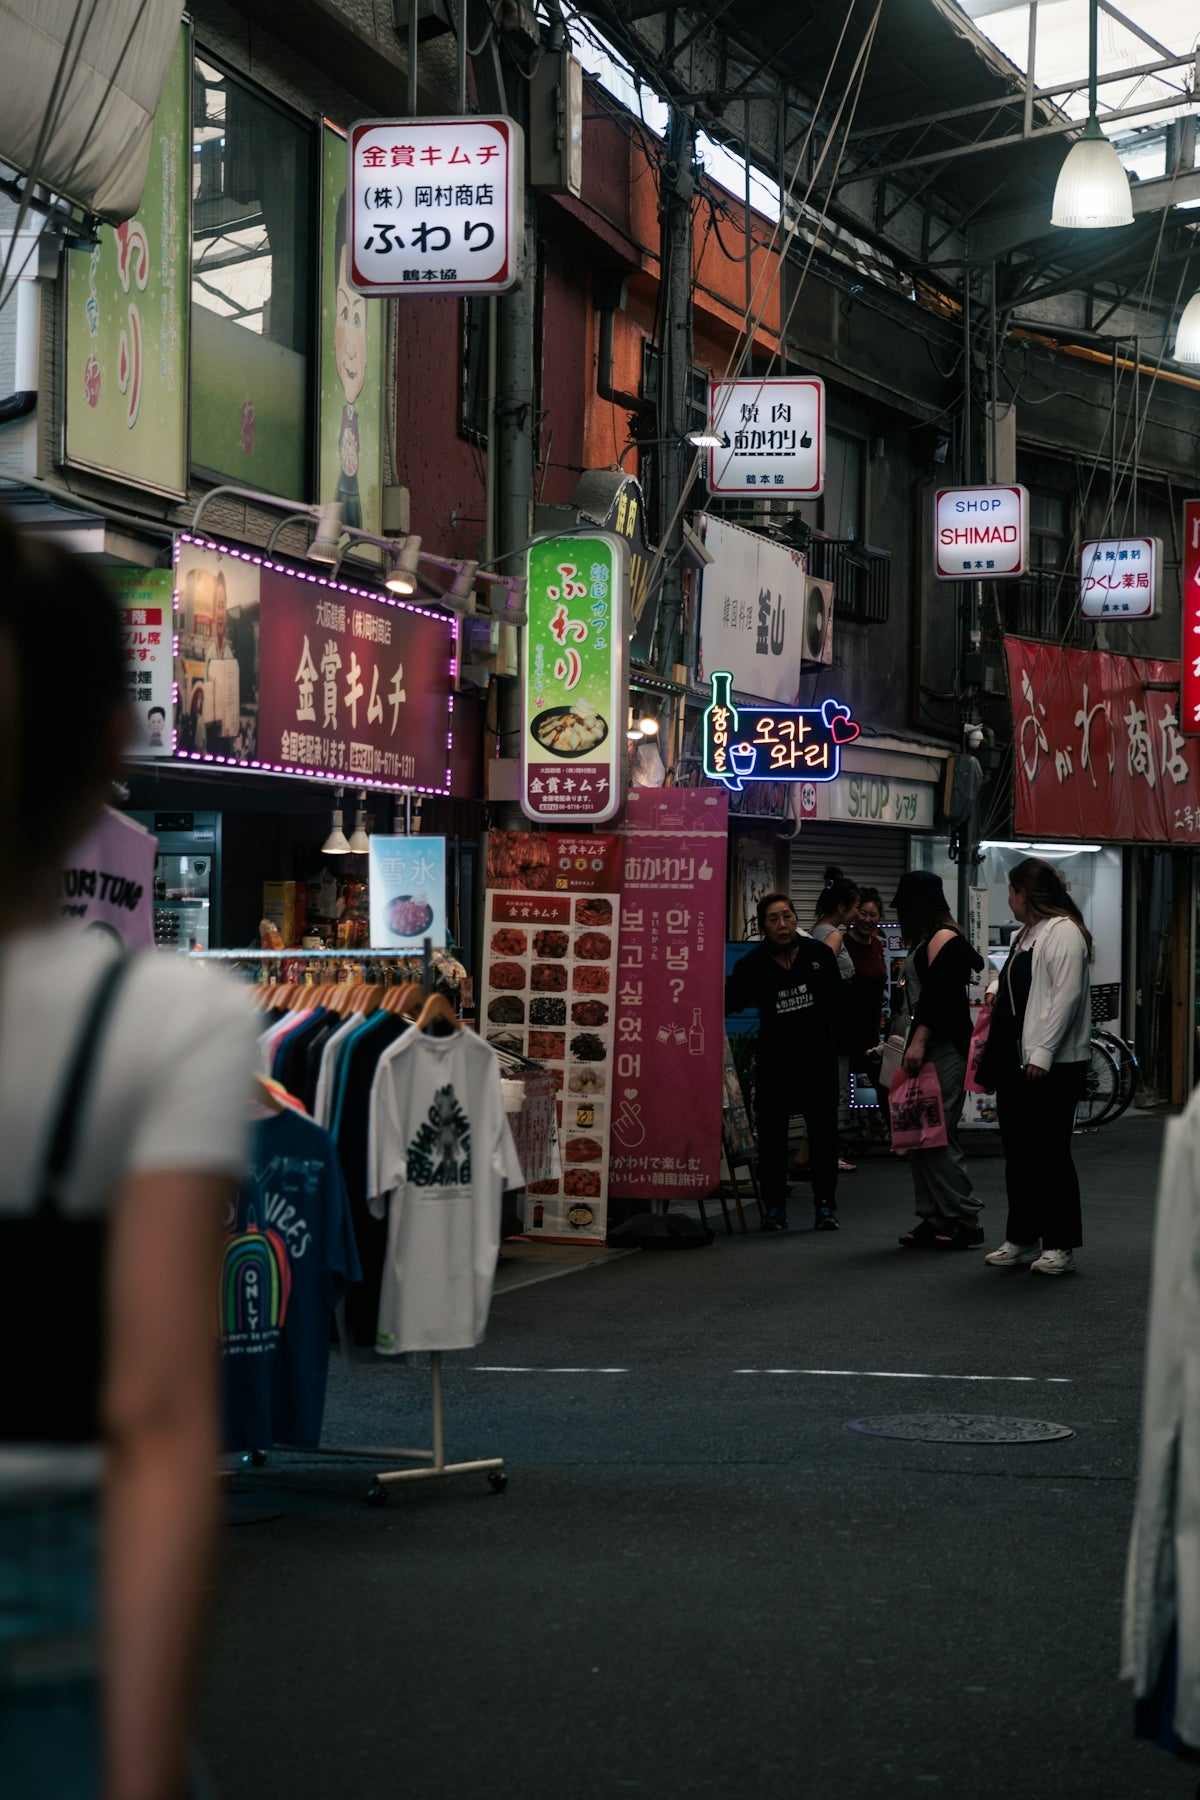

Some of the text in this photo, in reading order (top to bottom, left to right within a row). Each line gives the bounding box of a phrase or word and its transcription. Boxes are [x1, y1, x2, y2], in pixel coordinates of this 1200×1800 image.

[362, 145, 500, 168] 金賞キムチ
[363, 220, 495, 254] ふわり
[402, 269, 457, 281] 鶴本協
[740, 403, 791, 423] 焼肉
[734, 429, 796, 450] おかわり
[746, 474, 785, 485] 鶴本協
[955, 499, 1001, 512] SHOP
[940, 525, 1017, 545] SHIMAD
[962, 560, 995, 570] 鶴本協
[1083, 572, 1149, 590] つくし薬局
[589, 562, 609, 650] 韓国カフェ
[547, 562, 588, 691] ふわり
[295, 634, 407, 737] 金賞キムチ
[712, 705, 730, 772] 참이슬
[753, 716, 812, 743] 오카
[770, 741, 828, 769] 와리
[529, 776, 609, 794] 金賞キムチ
[848, 777, 890, 820] SHOP
[557, 844, 606, 855] 金賞キムチ
[381, 857, 439, 888] 雪氷
[624, 857, 694, 881] おかわり
[509, 907, 559, 918] 金賞キムチ
[697, 911, 705, 951] こんにちは
[264, 1191, 312, 1259] VIBES
[244, 1269, 259, 1330] ONLY
